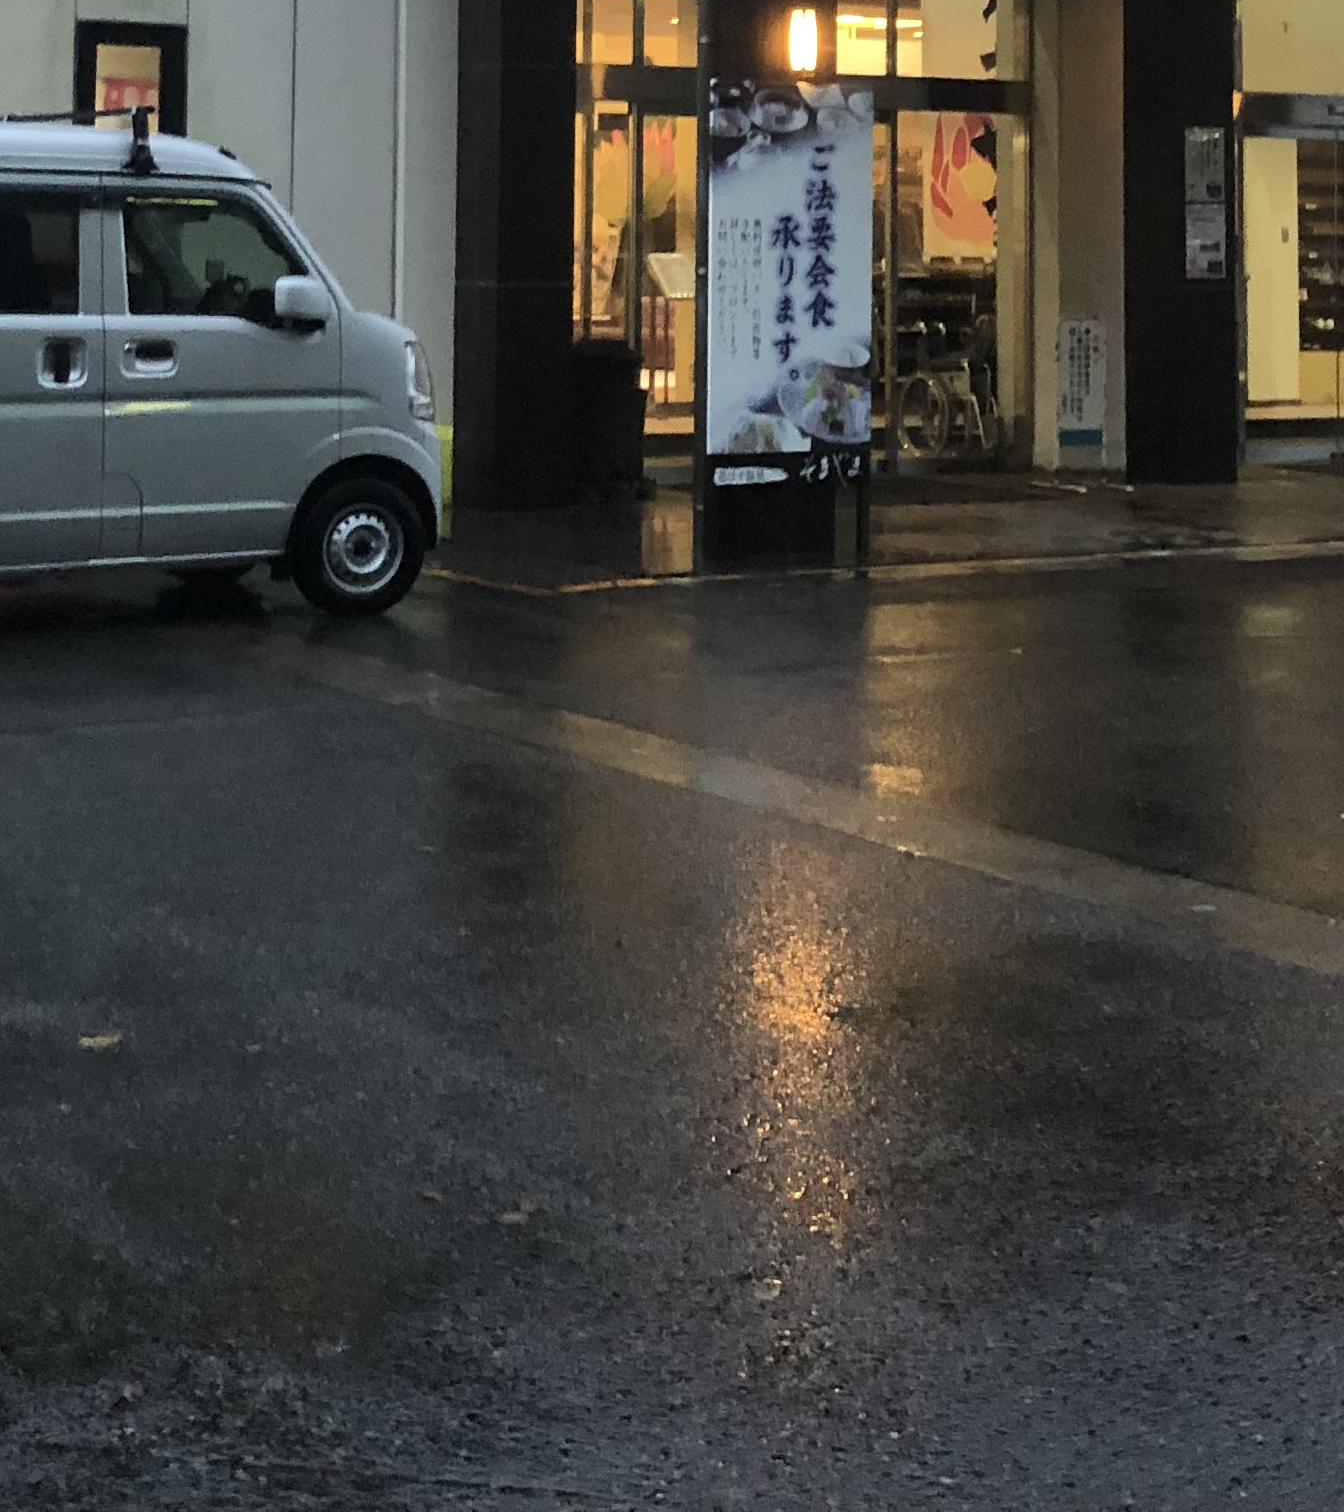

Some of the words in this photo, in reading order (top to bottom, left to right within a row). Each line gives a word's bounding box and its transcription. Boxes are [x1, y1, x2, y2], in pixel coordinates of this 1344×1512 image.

[771, 216, 801, 381] 承ります。
[805, 144, 836, 328] ご法要会食
